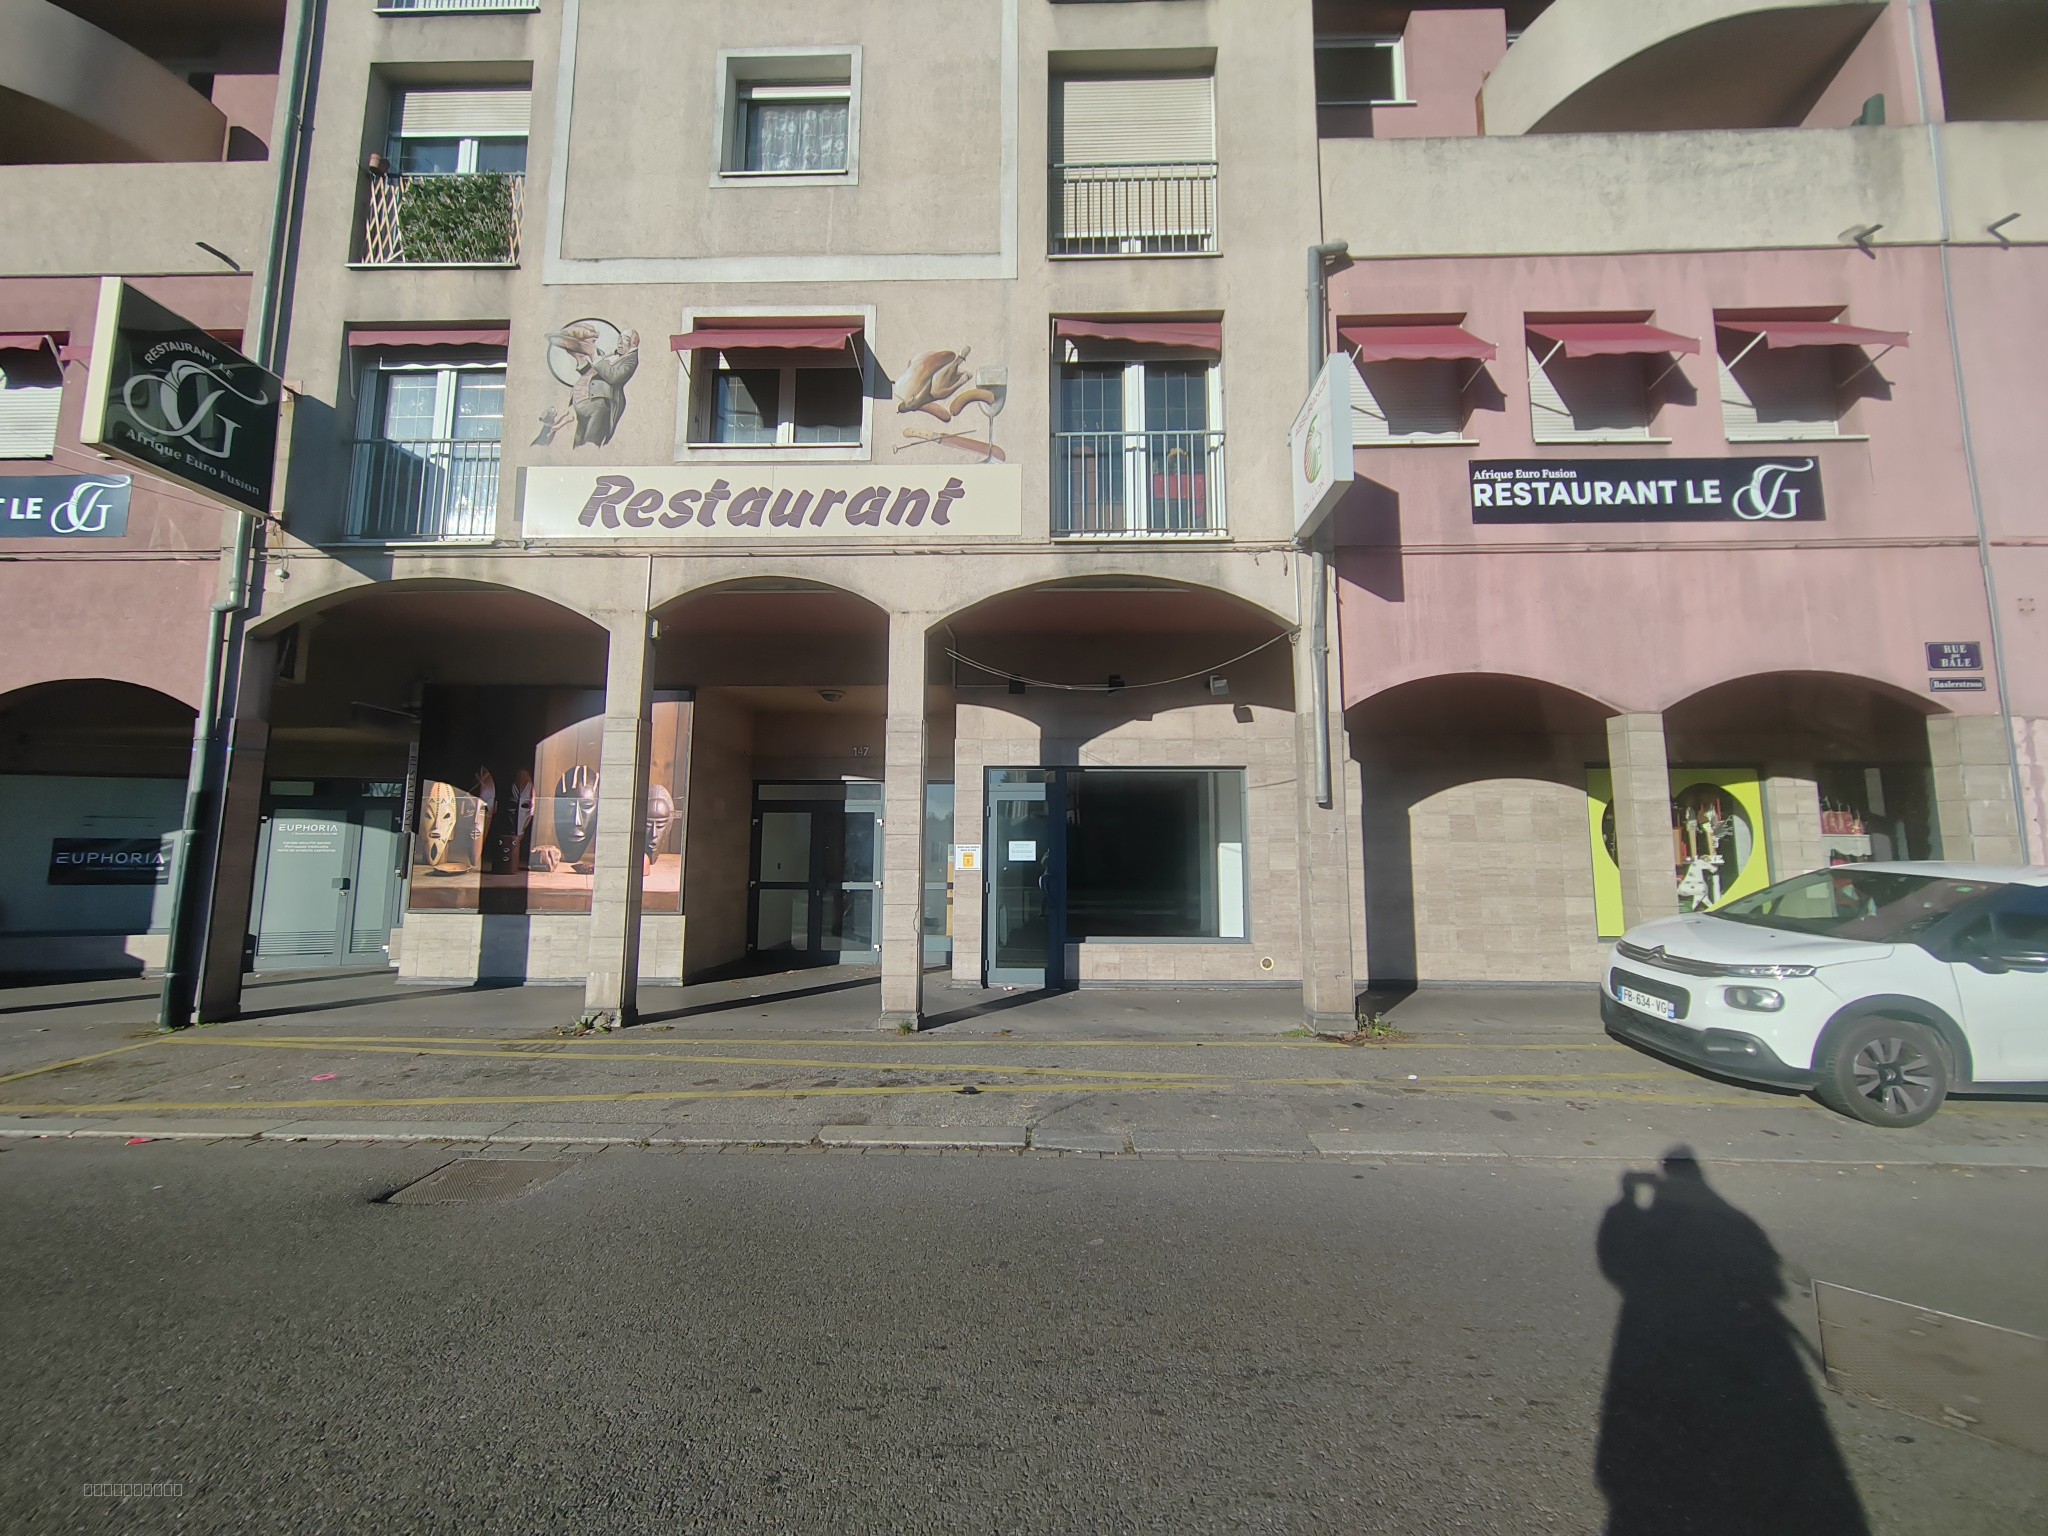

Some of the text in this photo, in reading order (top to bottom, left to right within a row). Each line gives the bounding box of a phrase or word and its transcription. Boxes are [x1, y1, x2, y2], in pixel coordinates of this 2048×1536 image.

[144, 341, 234, 380] RESTAURANT LE
[126, 428, 260, 495] Afrique Euro Fusion
[1473, 468, 1577, 481] Afrique Euro Fusion
[578, 474, 965, 528] Restaurant
[1473, 480, 1677, 507] RESTAURANT
[1686, 479, 1722, 504] LE
[10, 497, 43, 519] LE
[1943, 644, 1967, 654] RUE
[279, 823, 338, 832] EUPHORIA
[56, 852, 164, 864] EUPHORIA
